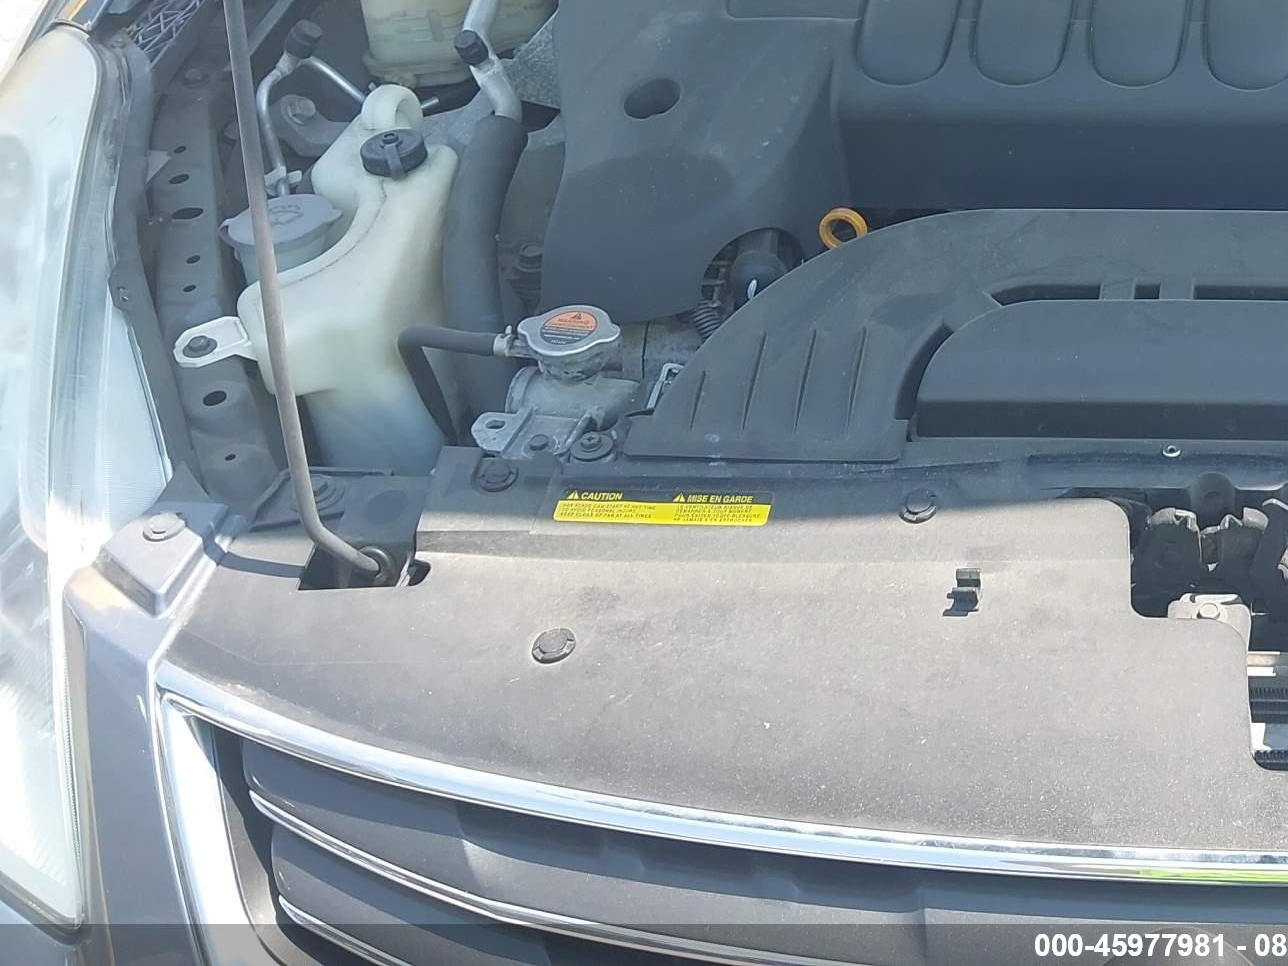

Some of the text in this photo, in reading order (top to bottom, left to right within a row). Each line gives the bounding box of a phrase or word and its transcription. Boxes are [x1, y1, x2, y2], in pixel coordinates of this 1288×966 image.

[581, 492, 623, 501] CAUTION
[687, 494, 753, 504] MISE EN GARDE
